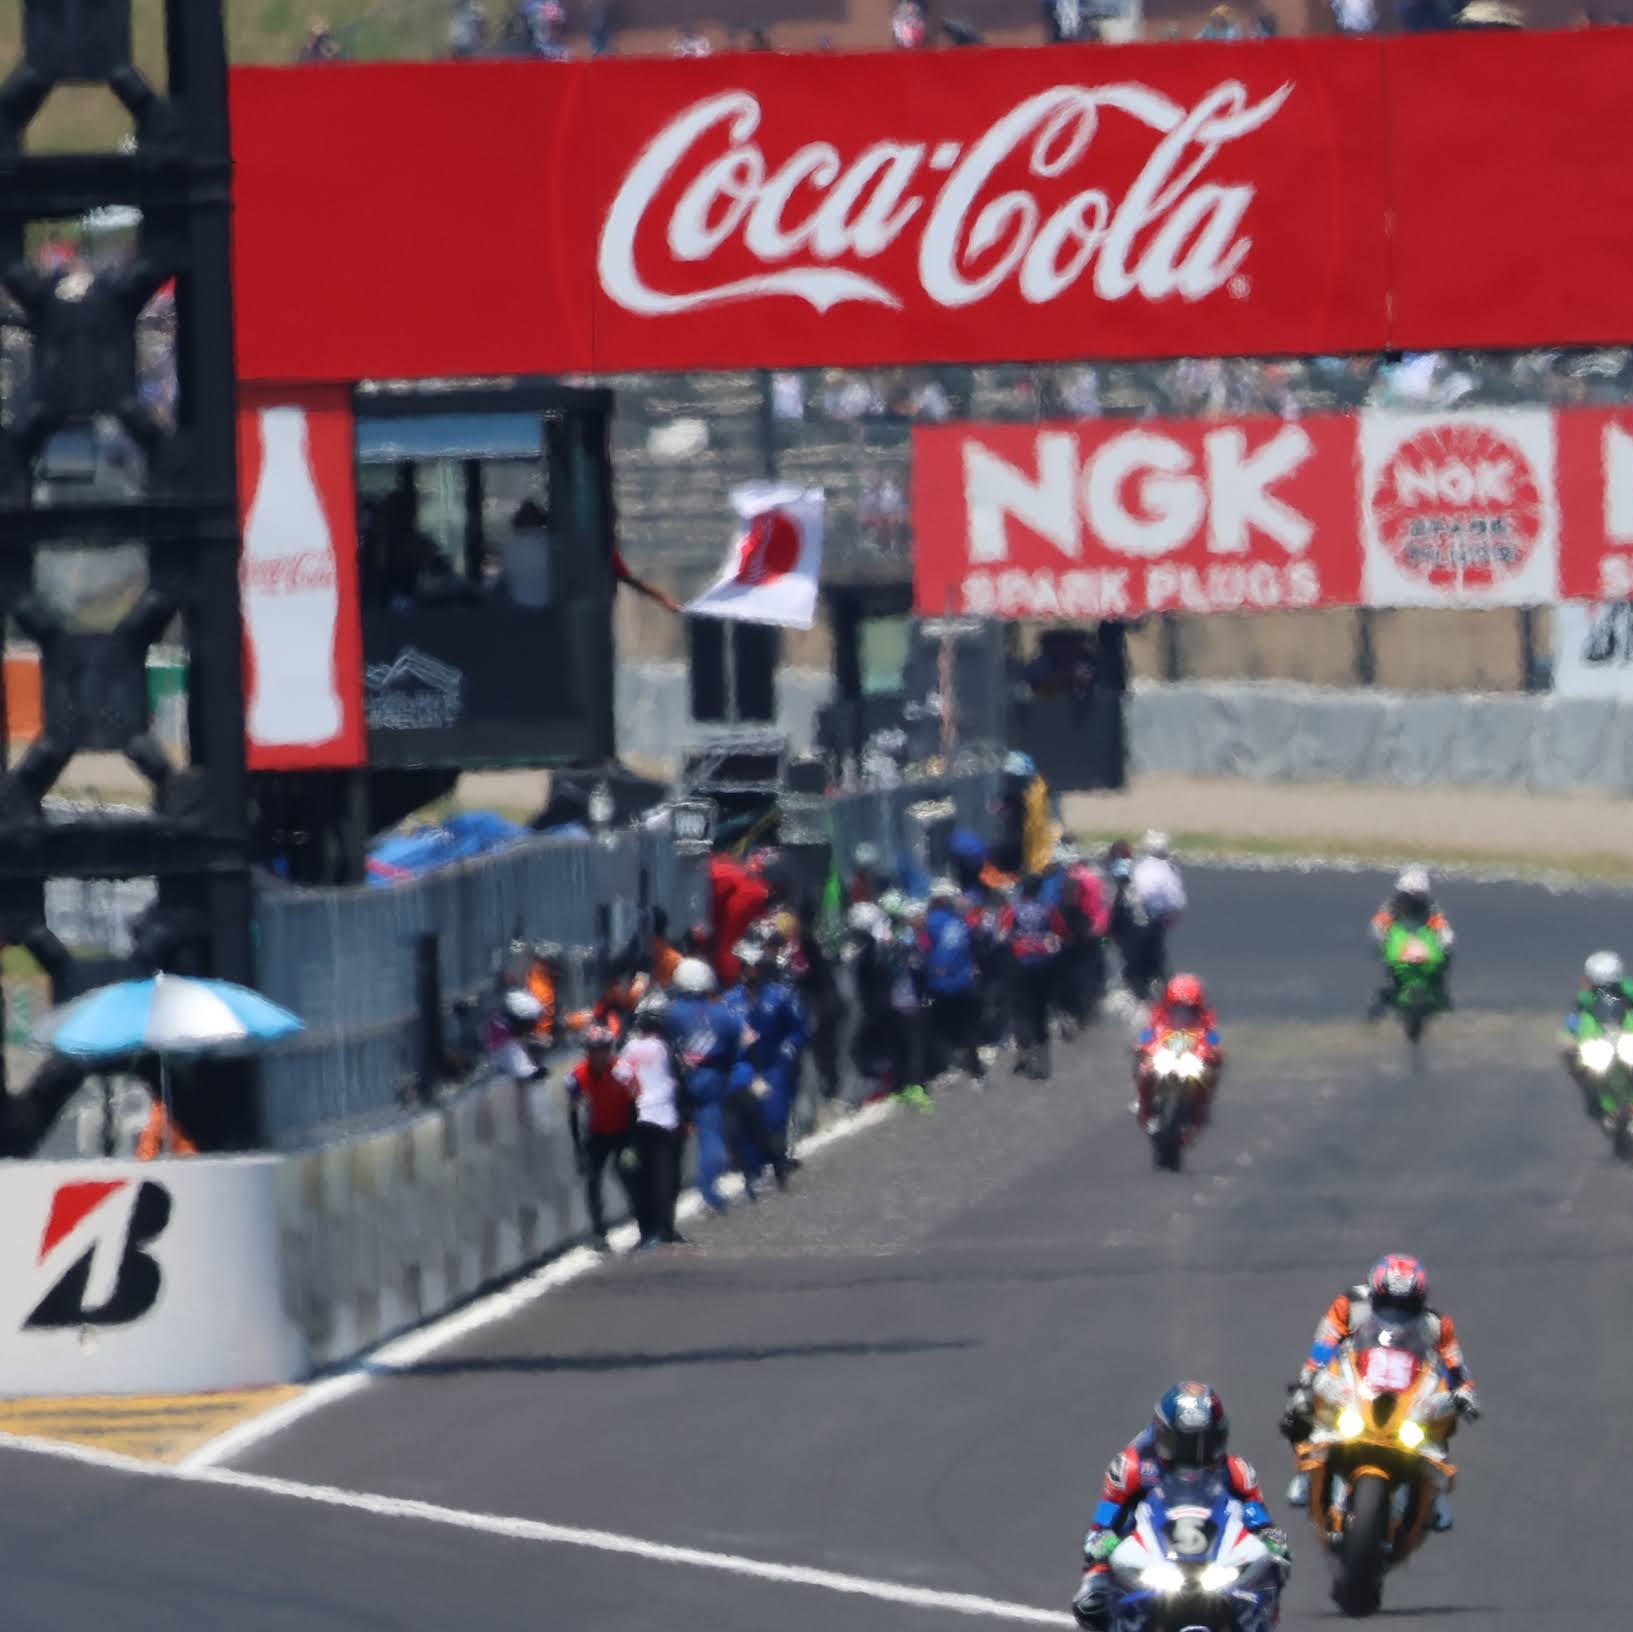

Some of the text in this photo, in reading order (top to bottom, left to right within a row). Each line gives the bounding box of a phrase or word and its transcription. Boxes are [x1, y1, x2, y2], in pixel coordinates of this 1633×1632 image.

[599, 78, 1294, 316] Coca-Cola
[962, 424, 1316, 564] NGK
[1395, 459, 1514, 505] NGK
[961, 560, 1321, 617] SPARK PLUGS
[1171, 1516, 1207, 1556] 5
